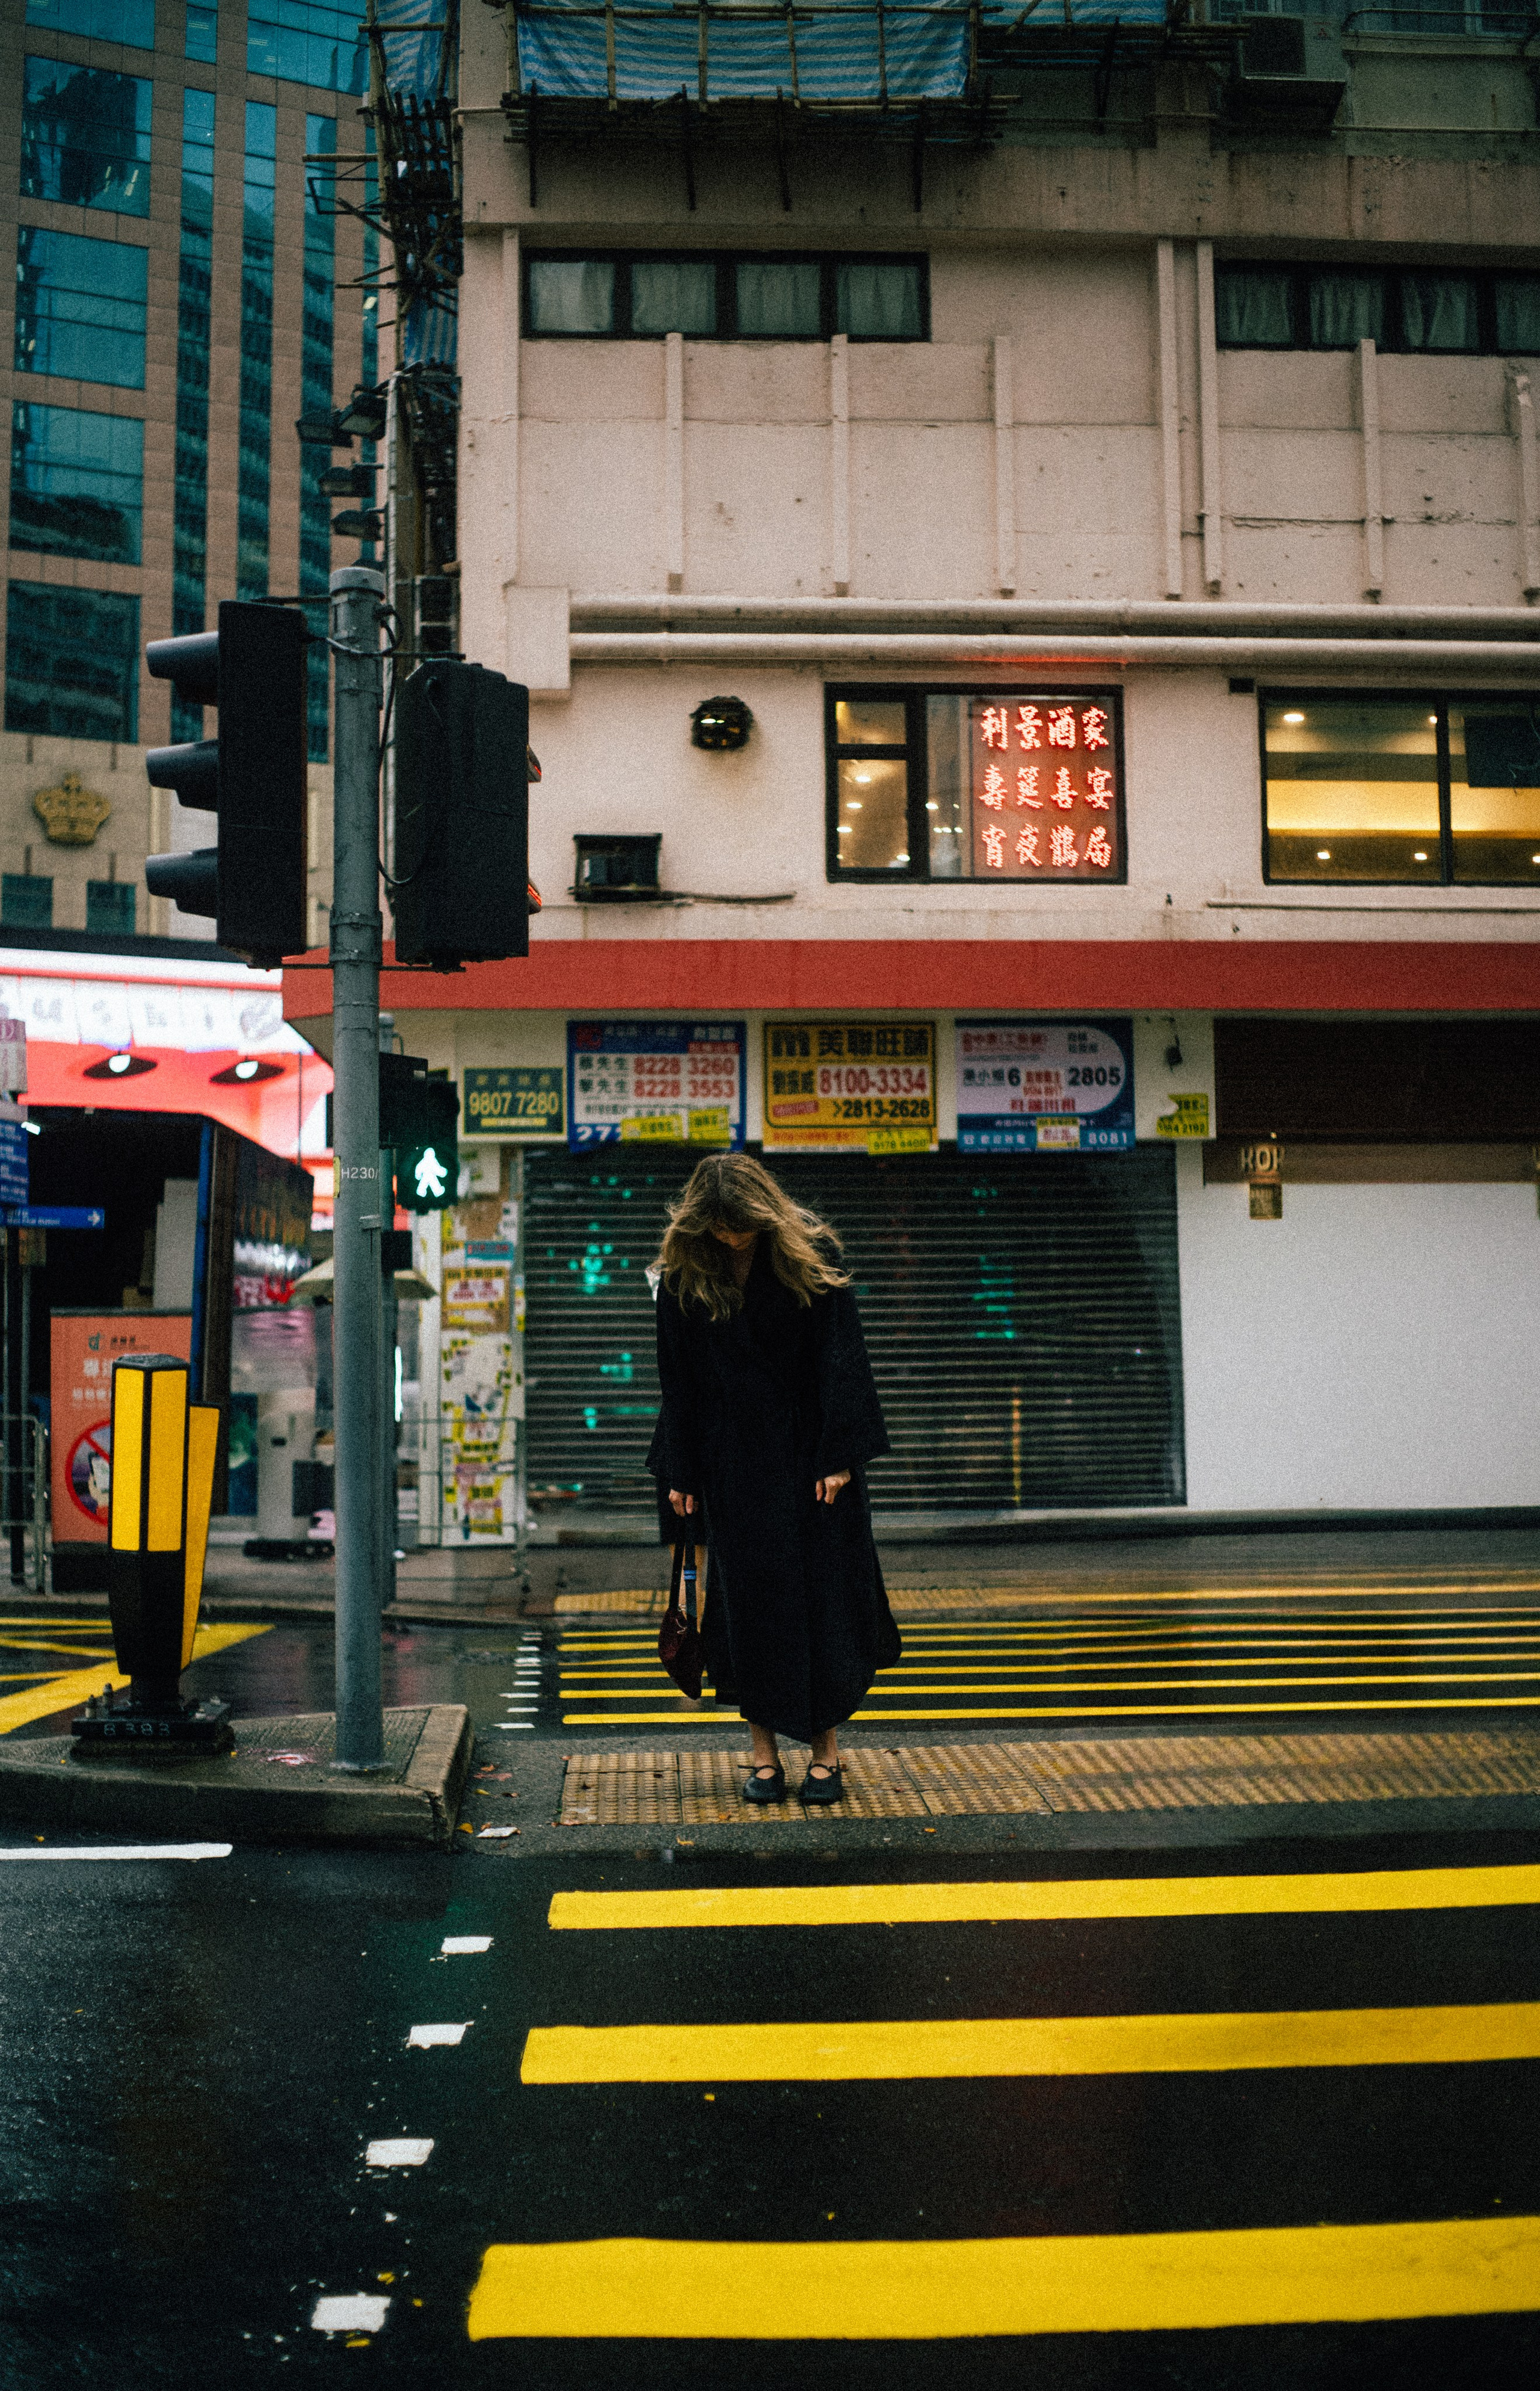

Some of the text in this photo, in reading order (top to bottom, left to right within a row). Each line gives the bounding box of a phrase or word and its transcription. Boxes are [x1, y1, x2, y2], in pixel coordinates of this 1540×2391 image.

[981, 706, 1109, 751] 利景酒家
[634, 1057, 681, 1075] 8228
[820, 1068, 926, 1094] 8100-3334
[1068, 1067, 1121, 1086] 2805
[634, 1080, 681, 1098] 8228
[688, 1080, 735, 1098] 3553
[469, 1092, 512, 1115] 9807
[516, 1092, 559, 1115] 7280
[842, 1100, 930, 1118] 2813-2628
